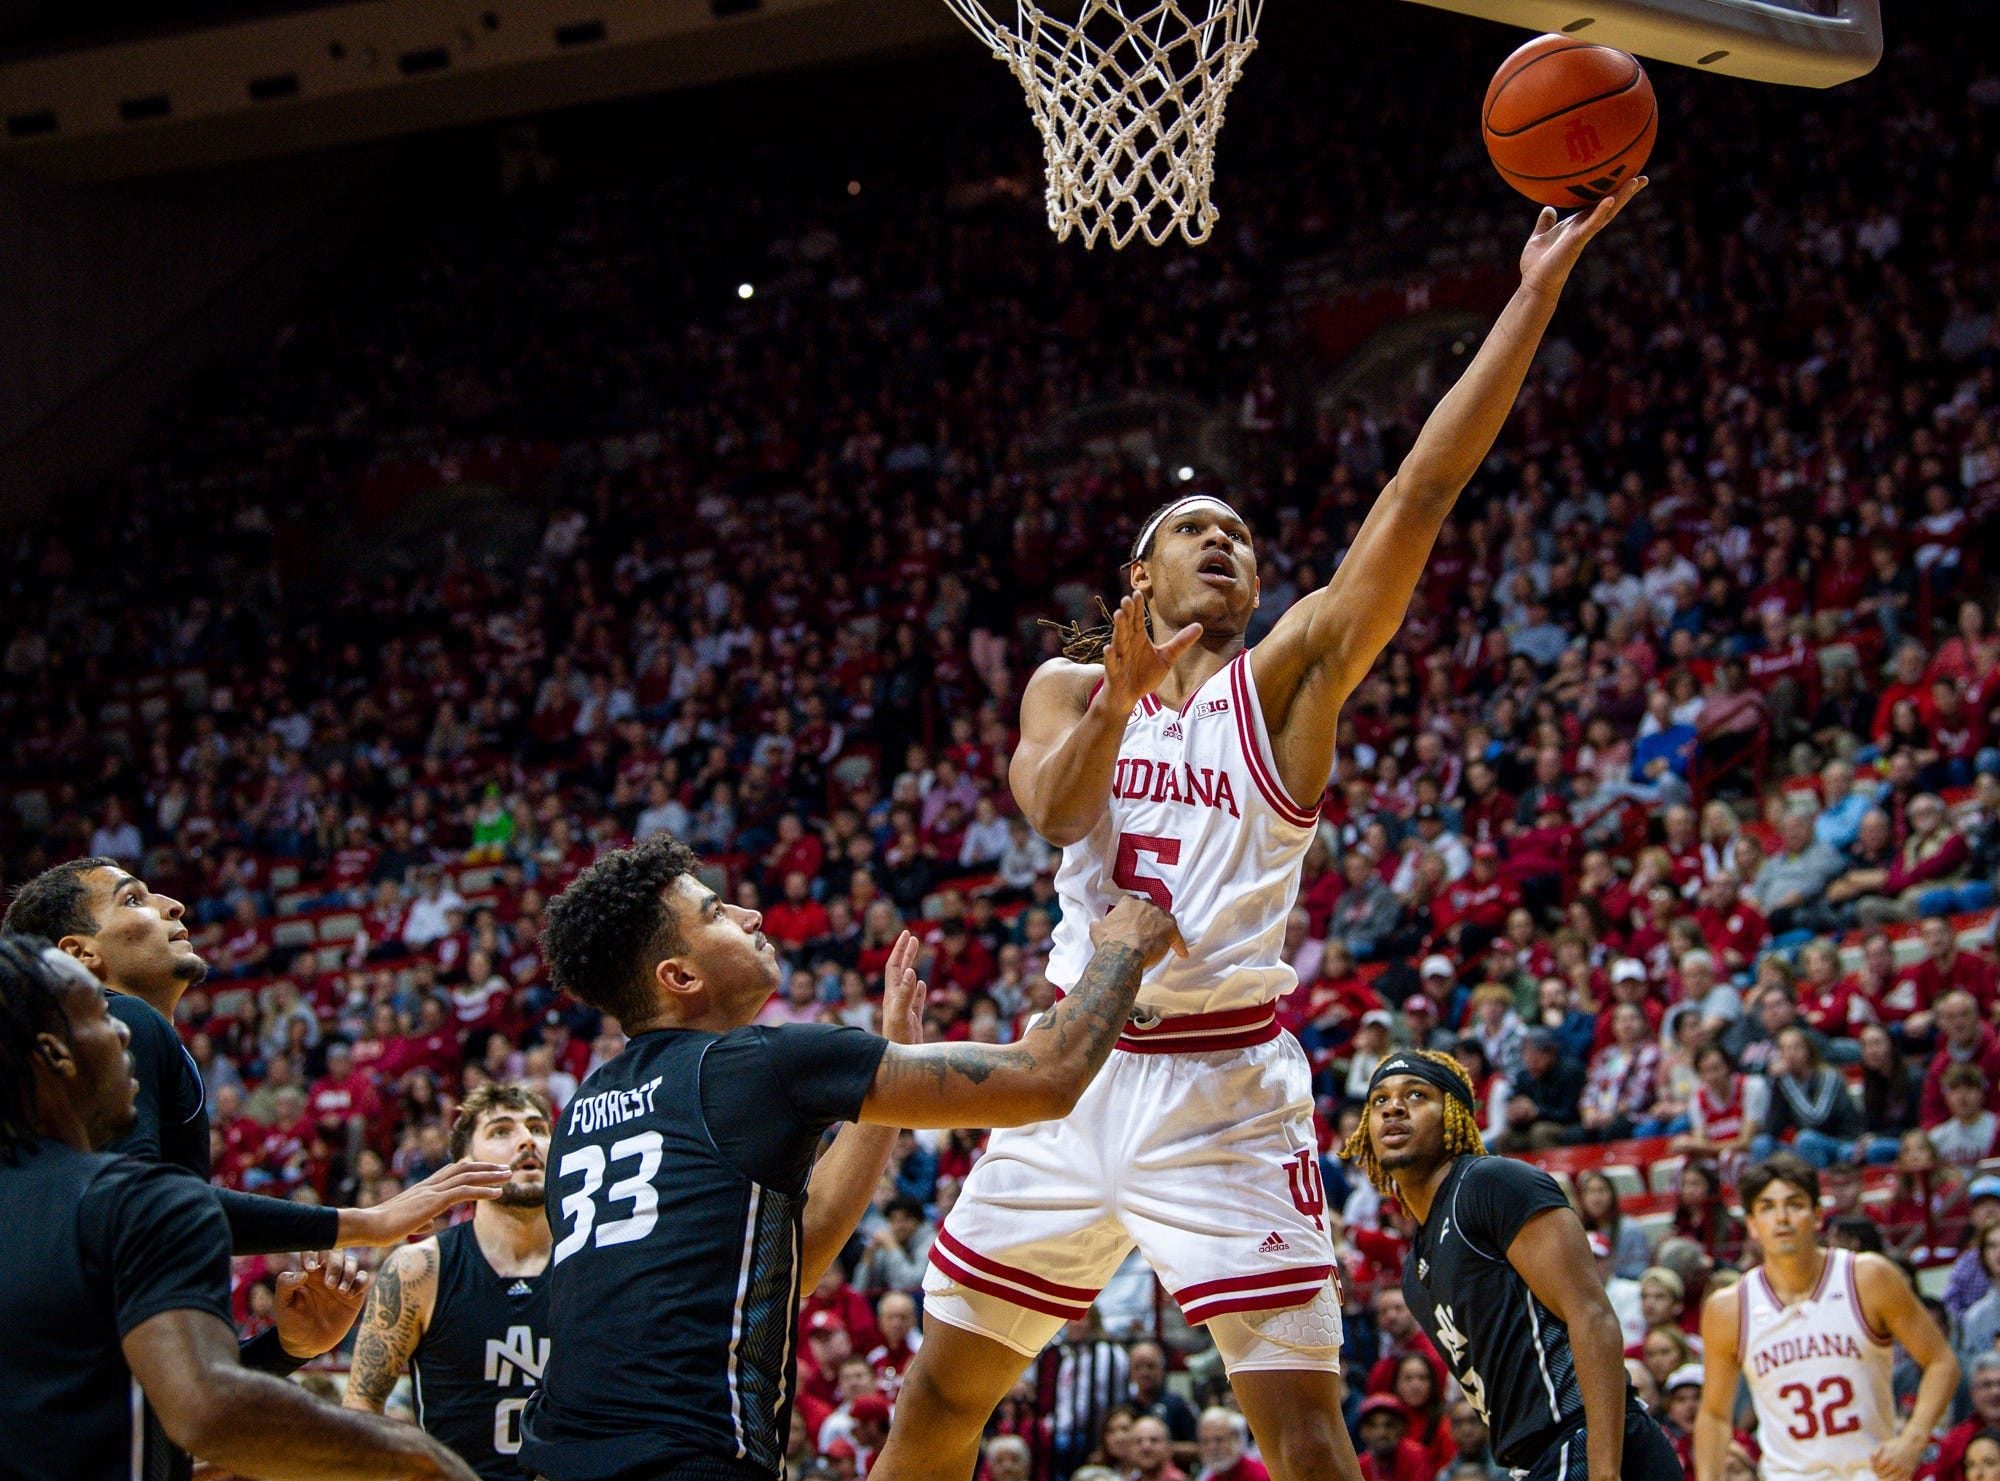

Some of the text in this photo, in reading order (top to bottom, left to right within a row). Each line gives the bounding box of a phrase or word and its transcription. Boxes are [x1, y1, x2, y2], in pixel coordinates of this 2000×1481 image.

[1113, 758, 1240, 820] NDIANA
[567, 1075, 664, 1136] FORREST
[554, 1130, 664, 1267] 33
[1258, 1243, 1290, 1253] adidas
[1753, 1333, 1862, 1378] INDIANA
[1778, 1375, 1862, 1441] 32
